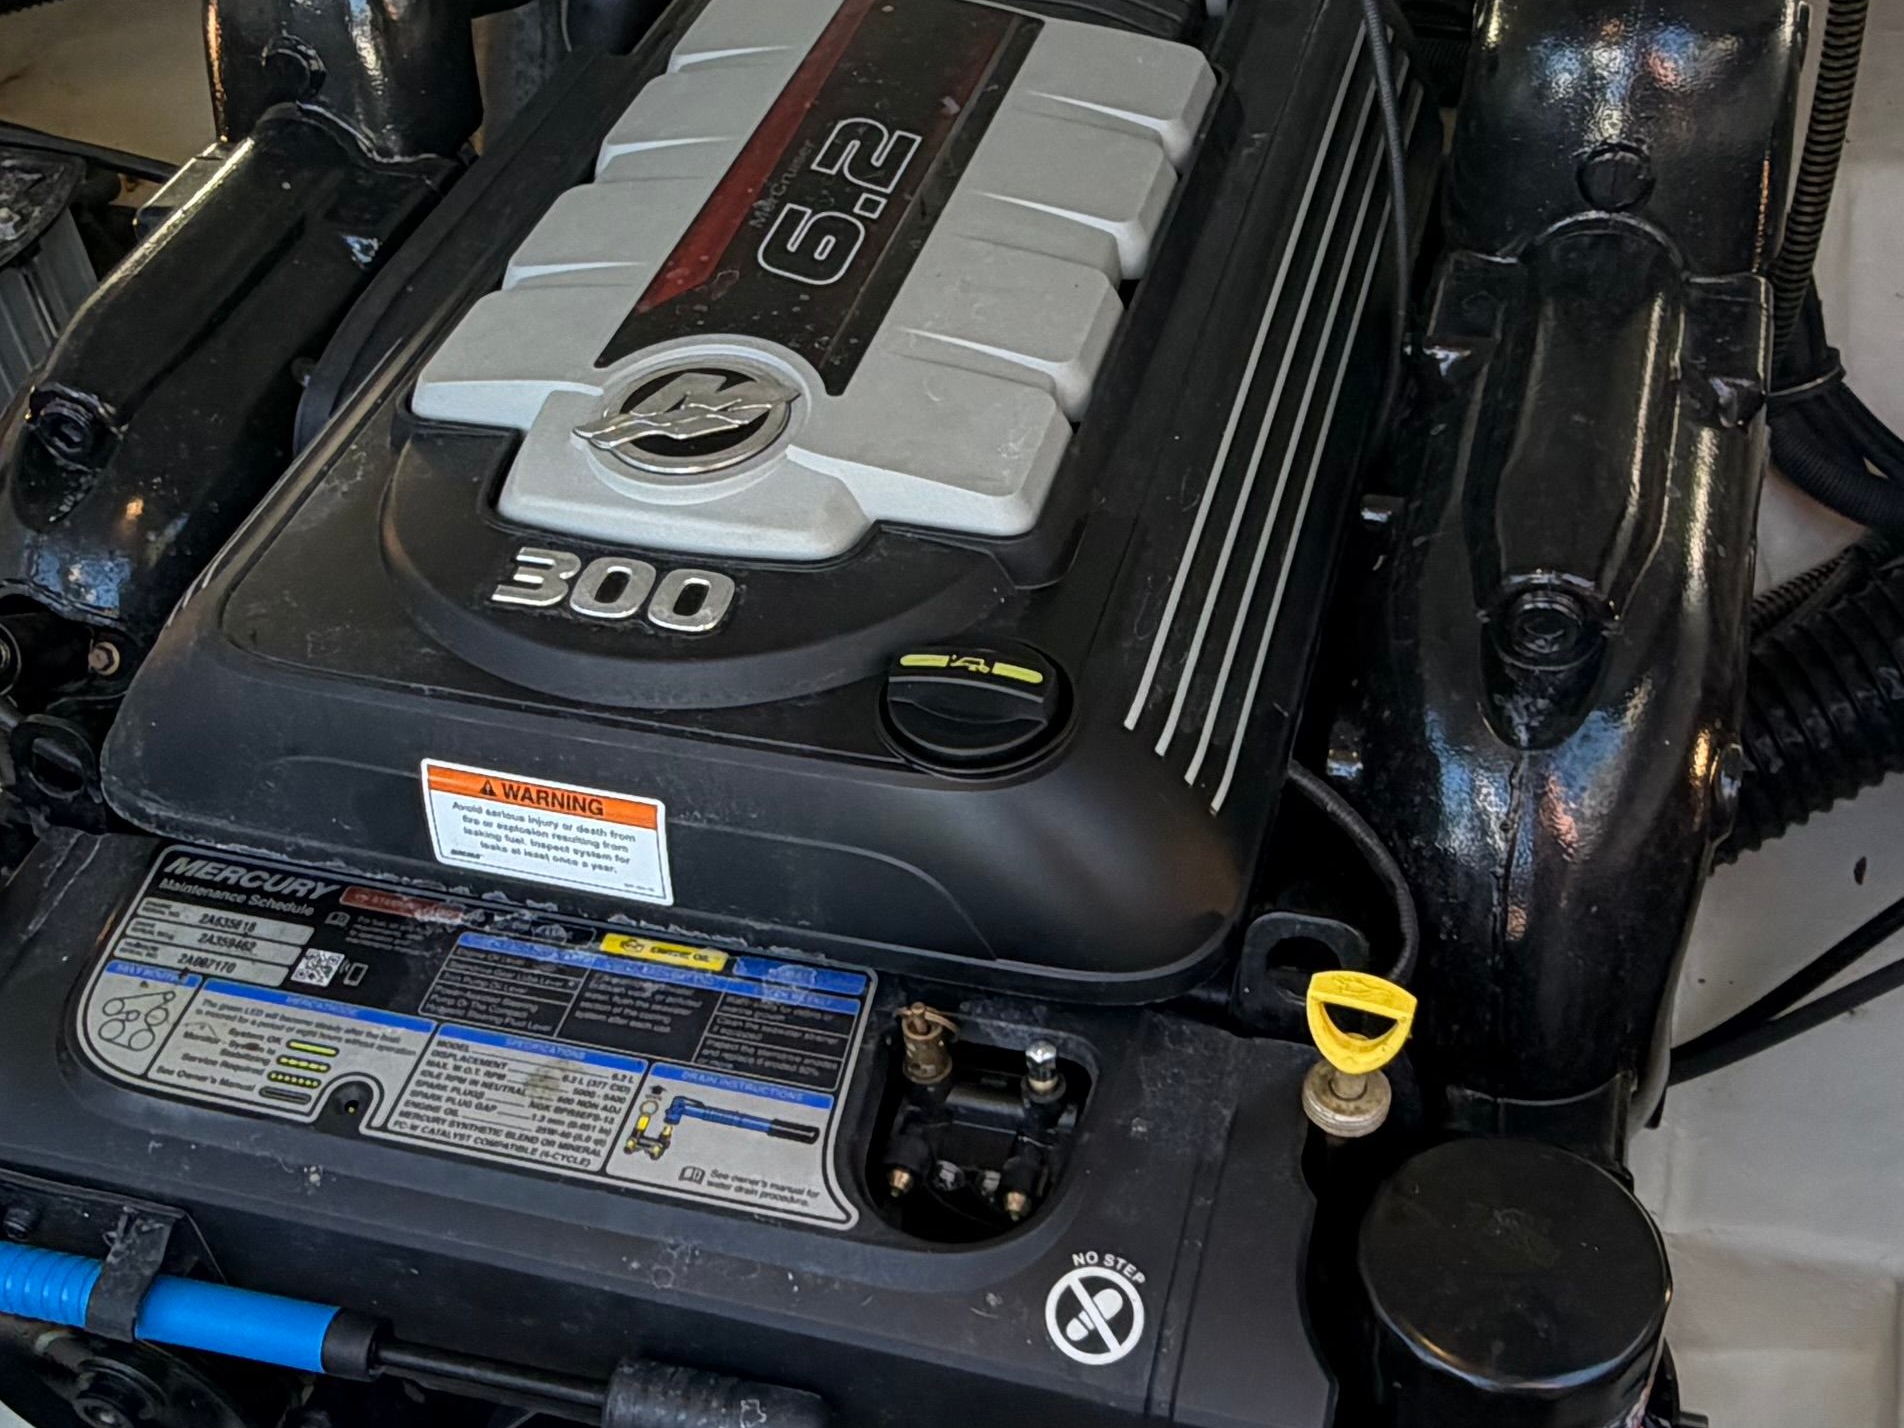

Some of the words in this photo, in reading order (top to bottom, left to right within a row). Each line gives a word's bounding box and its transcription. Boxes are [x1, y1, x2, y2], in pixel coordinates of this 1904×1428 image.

[757, 118, 923, 285] 6.2
[491, 547, 736, 633] 300
[501, 782, 604, 817] WARNING
[452, 801, 482, 813] Avoid
[485, 808, 524, 822] serious
[527, 815, 558, 830] injury
[562, 823, 572, 831] or
[576, 824, 606, 837] death
[609, 830, 635, 842] from
[462, 814, 479, 824] fire
[482, 819, 492, 827] or
[496, 822, 548, 839] explosion
[551, 831, 599, 849] resulting
[602, 841, 628, 852] from
[463, 826, 501, 841] leaking
[529, 839, 569, 855] Inspect
[572, 847, 611, 862] system
[614, 854, 630, 864] for
[159, 877, 246, 903] Maintenance
[249, 894, 315, 917] Schedule
[163, 856, 342, 900] MERCURY
[430, 1048, 508, 1070] DISPLACEMENT
[480, 1081, 527, 1096] NEUTRAL
[680, 1071, 717, 1086] DRAIN
[718, 1077, 803, 1102] INSTRUCTIONS
[397, 1109, 447, 1125] MERCURY
[447, 1119, 503, 1137] SYNTHETIC
[504, 1130, 539, 1144] BLEND
[556, 1141, 604, 1157] MINERAL
[707, 1179, 733, 1191] water
[734, 1181, 759, 1196] drain
[710, 1169, 730, 1181] See
[731, 1173, 769, 1188] owner's
[769, 1180, 806, 1196] manual
[806, 1188, 820, 1199] for
[1072, 1251, 1099, 1266] NO
[1103, 1253, 1146, 1284] STEP
